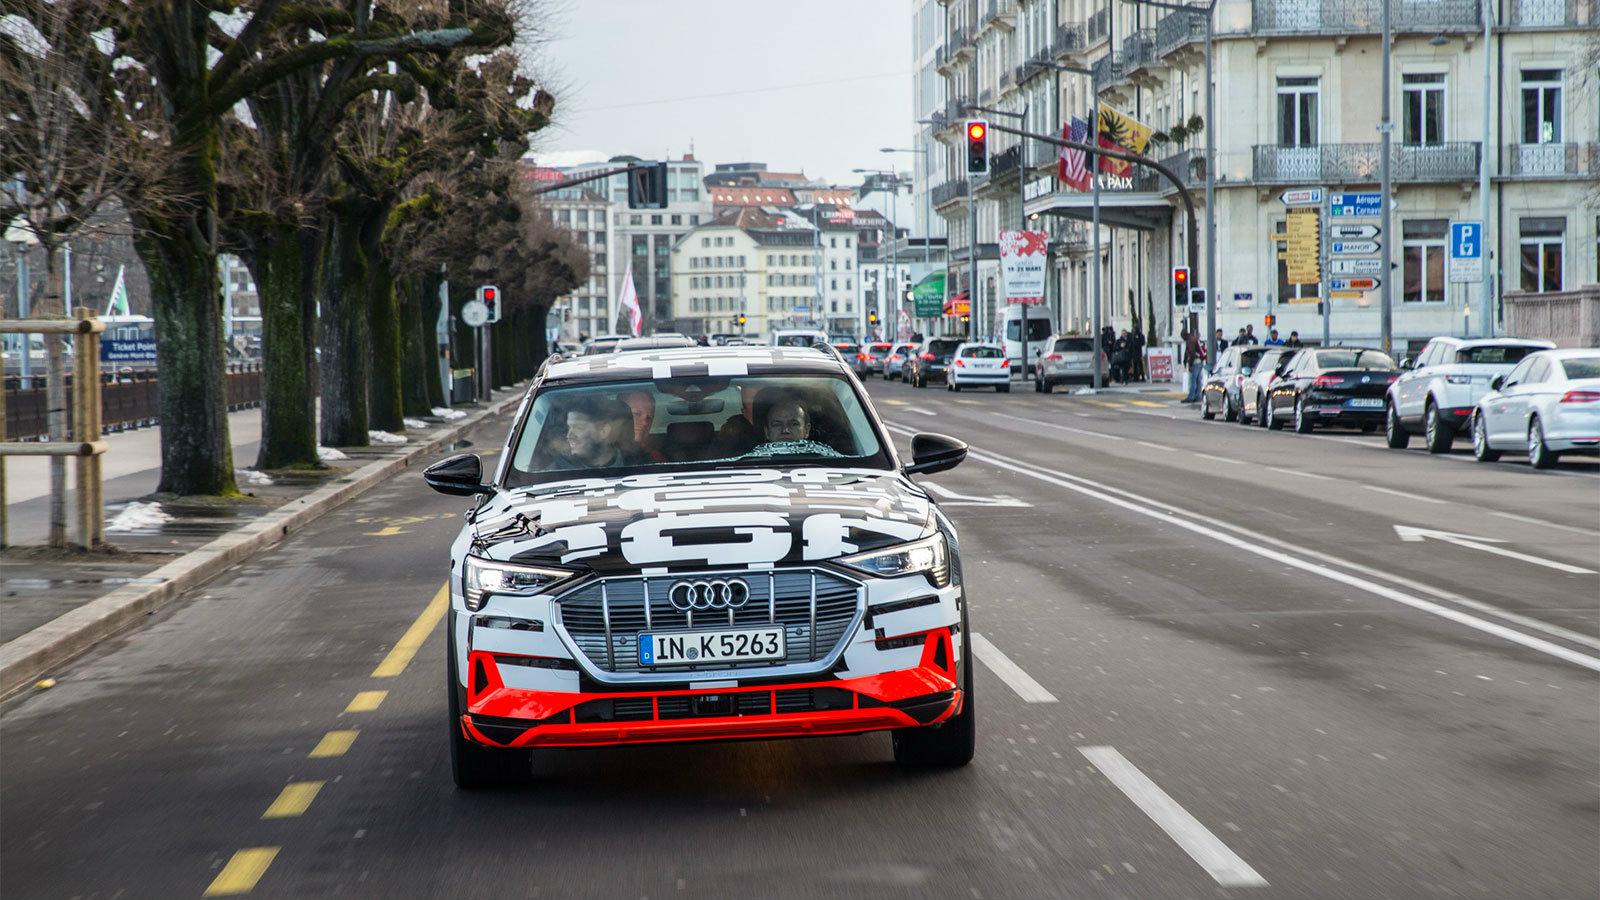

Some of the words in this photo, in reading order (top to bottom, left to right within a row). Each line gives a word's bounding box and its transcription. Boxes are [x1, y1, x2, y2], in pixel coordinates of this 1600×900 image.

[1107, 176, 1133, 189] PAIX
[1356, 195, 1381, 205] Aéropor
[1356, 206, 1382, 215] Cornavi
[1461, 226, 1473, 243] P
[1343, 243, 1370, 251] MANOR
[113, 342, 136, 351] Ticket
[657, 637, 685, 660] IN
[701, 635, 715, 658] K
[721, 632, 779, 657] 5263
